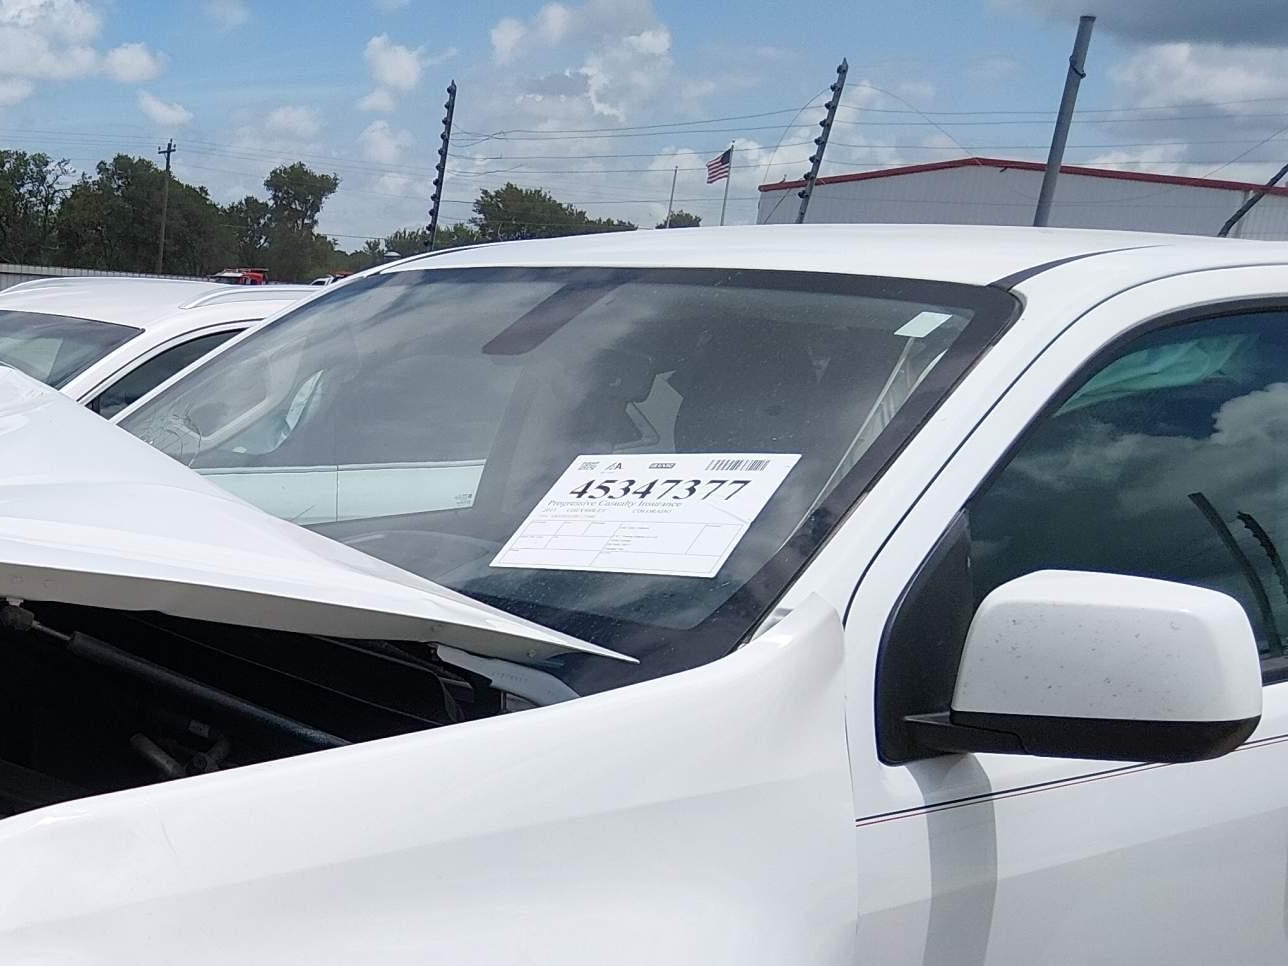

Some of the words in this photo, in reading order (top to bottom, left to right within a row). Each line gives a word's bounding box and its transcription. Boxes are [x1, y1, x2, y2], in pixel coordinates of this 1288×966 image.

[569, 478, 752, 500] 45347377
[547, 499, 597, 508] Progressive
[598, 499, 634, 509] Casualty
[638, 500, 682, 508] Insurance
